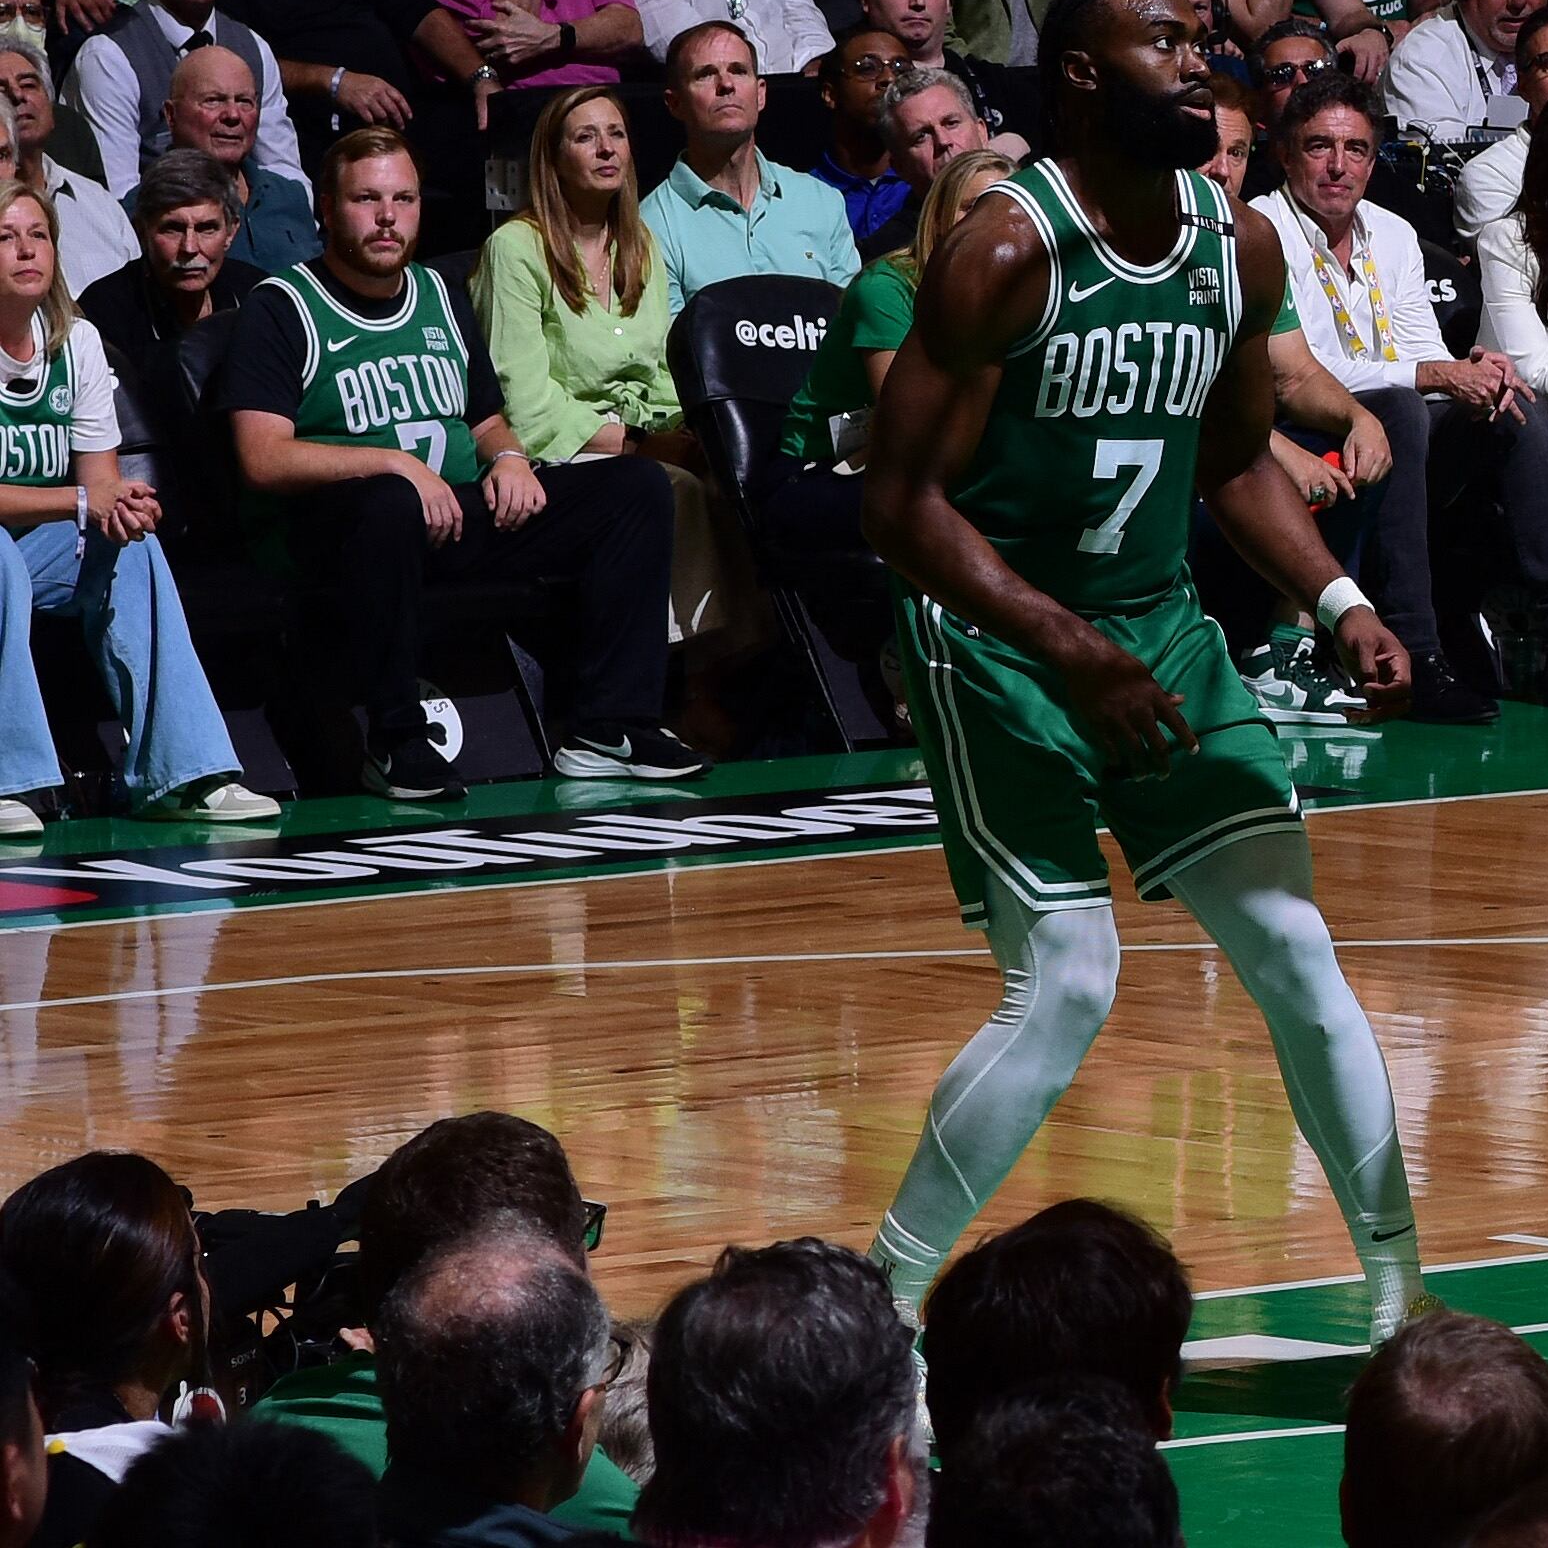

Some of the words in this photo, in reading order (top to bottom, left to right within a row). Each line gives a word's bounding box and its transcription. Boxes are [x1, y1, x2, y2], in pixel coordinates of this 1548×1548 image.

[1187, 267, 1220, 290] VISTA
[1189, 289, 1221, 306] PRINT
[735, 314, 827, 351] @celti
[335, 354, 467, 435] BOSTON
[1034, 321, 1227, 420] BOSTON
[394, 419, 448, 476] 7
[1075, 438, 1165, 555] 7
